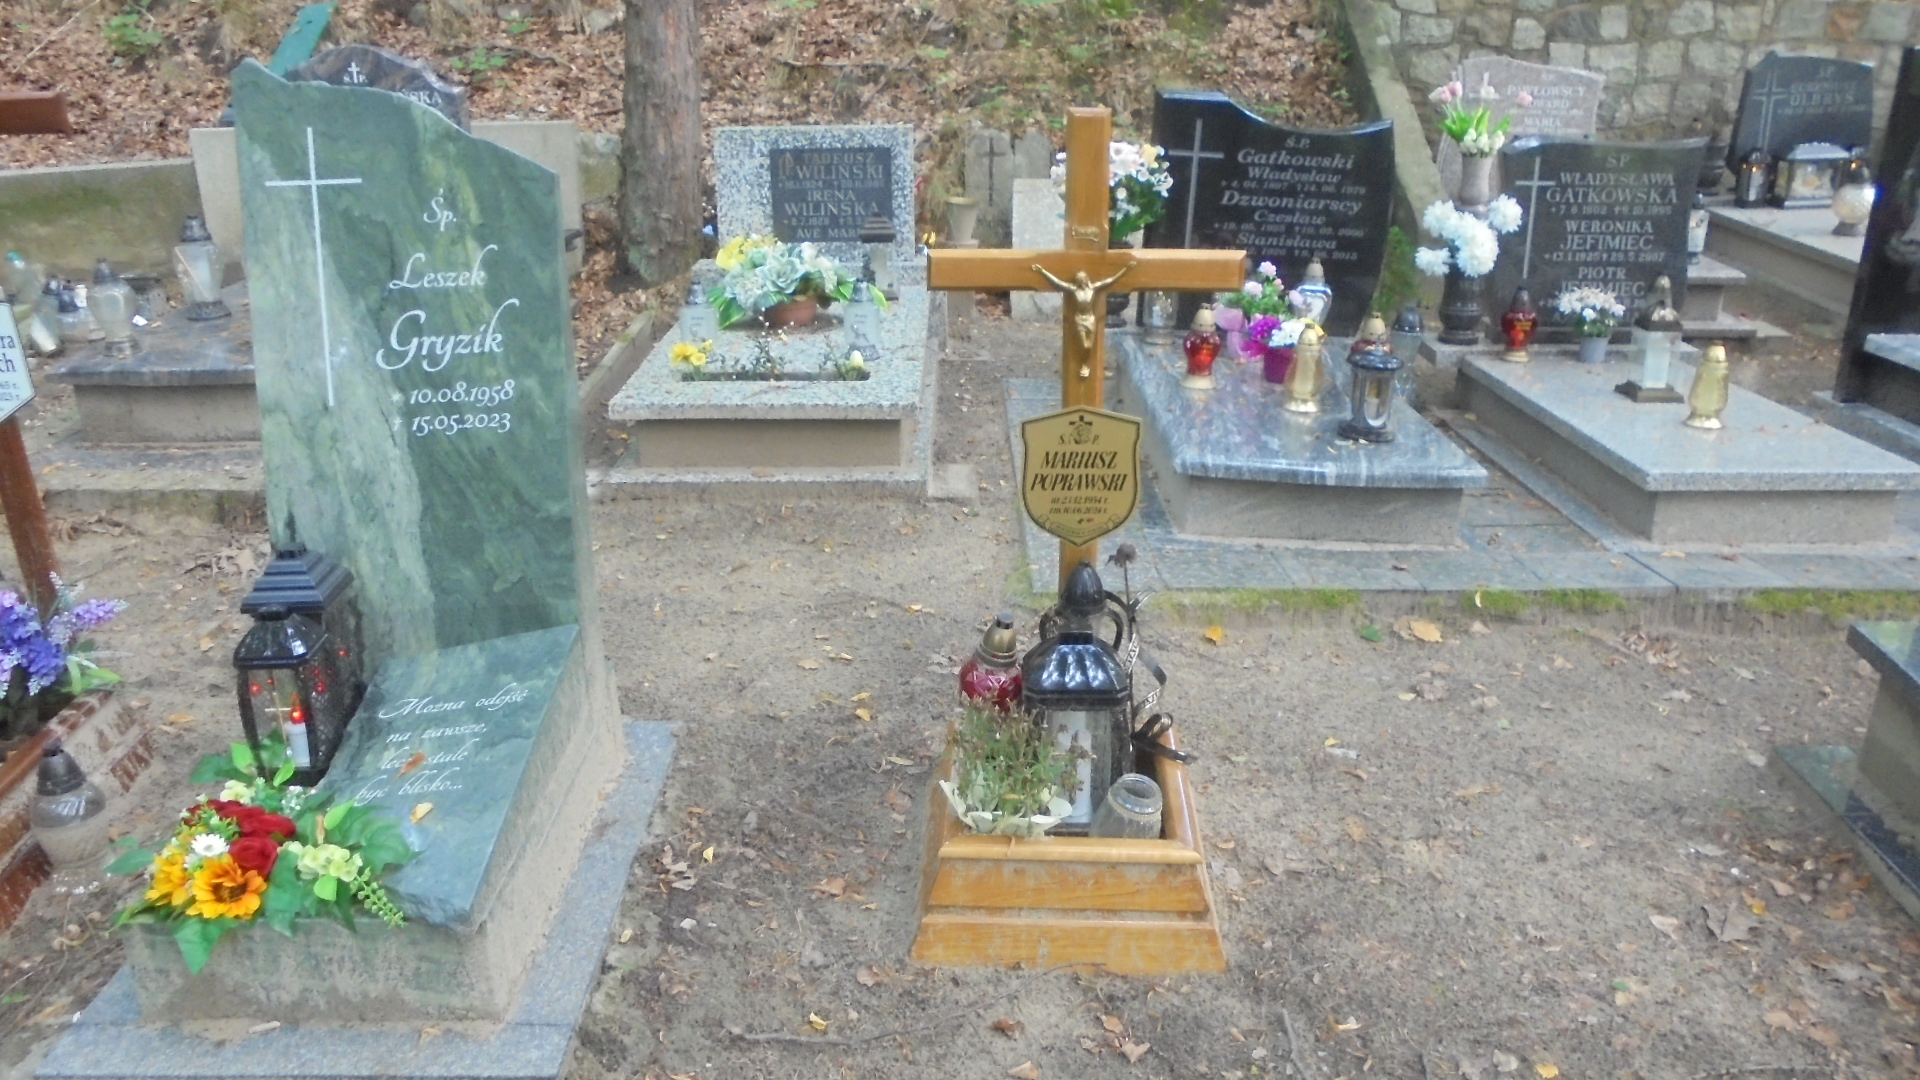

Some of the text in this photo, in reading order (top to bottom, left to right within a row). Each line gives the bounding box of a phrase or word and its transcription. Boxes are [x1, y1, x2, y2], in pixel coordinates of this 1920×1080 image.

[803, 152, 875, 165] TADEUSZ
[1237, 149, 1355, 169] Gatkowski
[1247, 166, 1342, 183] Władysław
[1559, 171, 1675, 186] WŁADYSŁAWA
[807, 189, 857, 201] IRENA
[1220, 190, 1363, 214] Dzwoniarscy
[1546, 187, 1678, 204] GATKOWSKA
[797, 228, 821, 239] AVE
[1565, 220, 1654, 234] WERONIKA
[1236, 232, 1337, 249] Stanisława
[1560, 234, 1654, 250] JEFIMIEC
[389, 244, 498, 289] Leszek
[1578, 266, 1627, 279] PIOTR
[376, 298, 520, 372] Gryzik
[410, 379, 516, 407] 10.08.1958
[412, 412, 511, 436] 15.05.2023
[1041, 451, 1118, 470] MARIUSZ
[1030, 473, 1128, 492] POPRAWSKI
[378, 683, 530, 719] Można odejść
[386, 723, 488, 743] na zawsze,
[381, 738, 480, 770] lec stale
[353, 767, 464, 808] być blisko...
